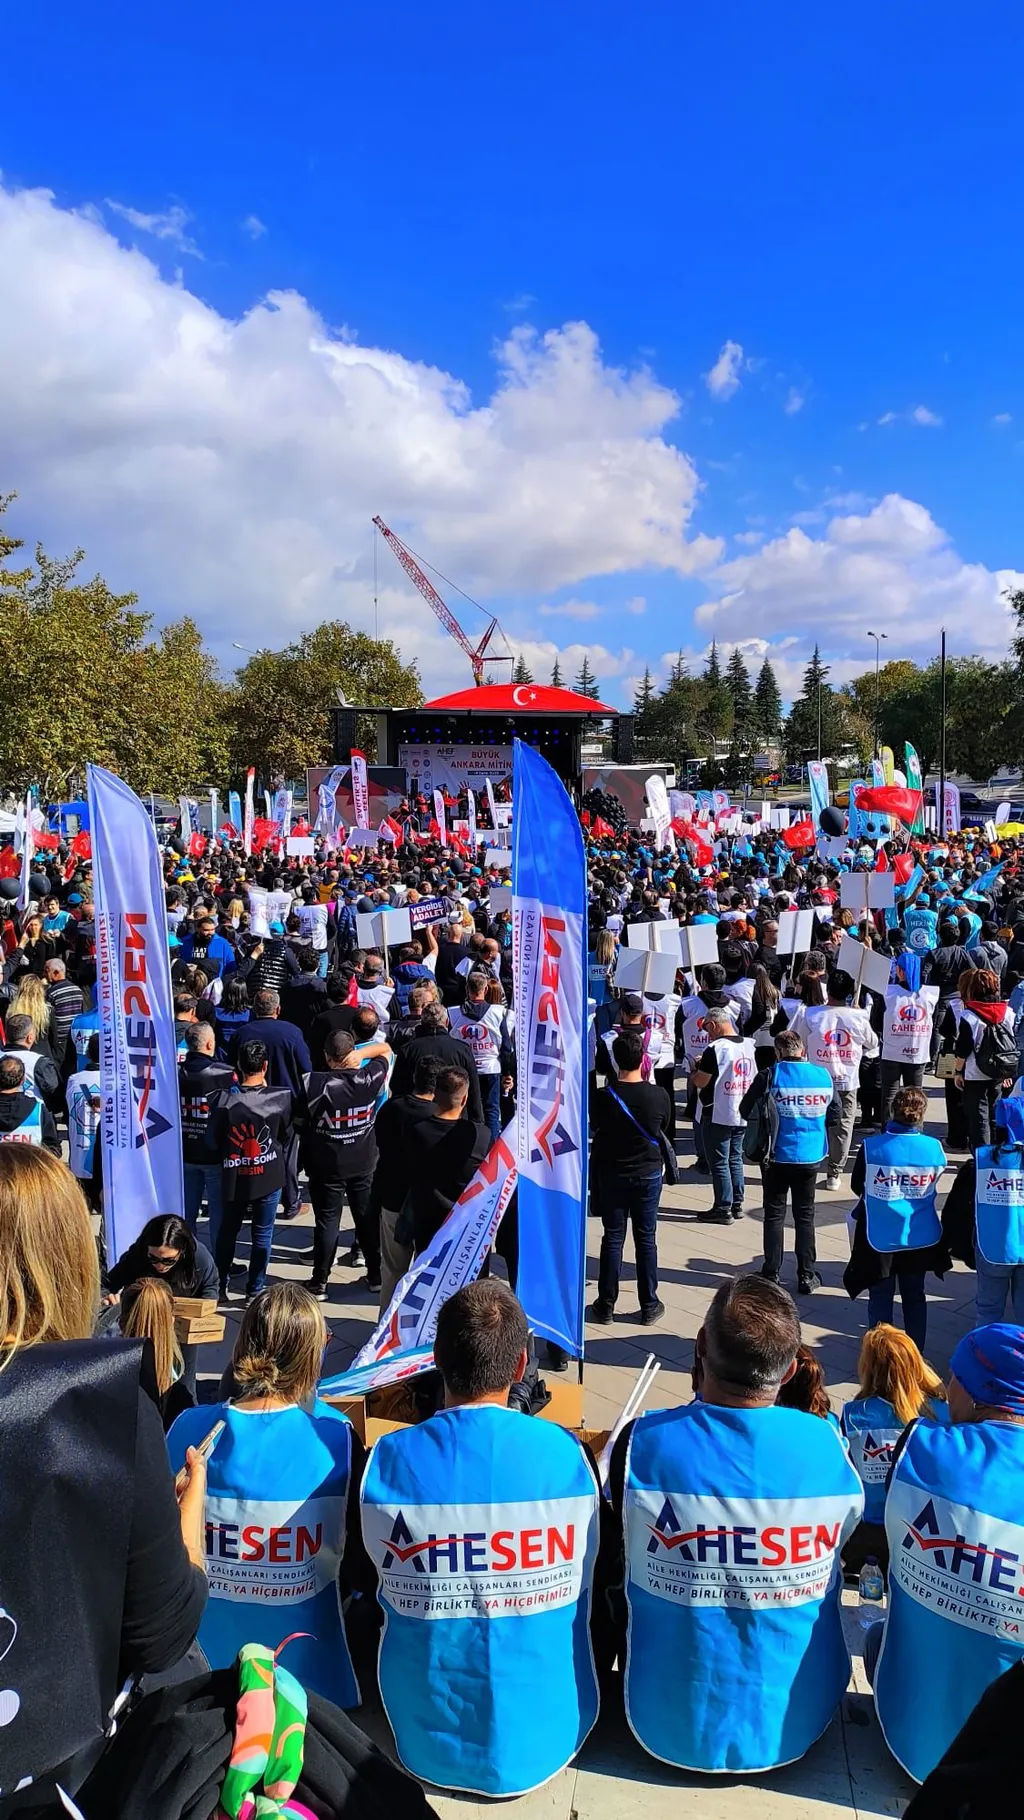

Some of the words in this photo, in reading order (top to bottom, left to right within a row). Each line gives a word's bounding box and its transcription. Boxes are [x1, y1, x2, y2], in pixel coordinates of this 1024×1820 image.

[450, 761, 485, 769] ANKARA
[471, 750, 500, 759] BÜYÜK
[410, 901, 443, 914] VERGİDE
[413, 908, 444, 921] ADALET
[253, 1150, 277, 1165] SONA
[874, 1166, 937, 1187] AHESEN
[380, 1509, 575, 1573] AHESEN
[645, 1496, 840, 1566] AHESEN
[901, 1498, 1024, 1597] AHE
[211, 1565, 269, 1579] ÇALIŞANLARI
[403, 1580, 452, 1592] HEKİMLİĞİ
[456, 1581, 522, 1592] ÇALIŞANLARI
[526, 1570, 572, 1587] SENDİKASI
[647, 1561, 665, 1574] AİLE
[668, 1569, 721, 1581] HEKİMLİĞİ
[725, 1574, 791, 1584] ÇALIŞANLARI
[901, 1556, 916, 1572] AİLE
[918, 1569, 971, 1599] HEKİMLİĞİ
[233, 1585, 247, 1595] YA
[647, 1577, 661, 1590] YA
[664, 1580, 685, 1596] HEP
[690, 1586, 751, 1602] BİRLİKTE,
[753, 1591, 768, 1600] YA
[900, 1571, 910, 1585] YA
[911, 1583, 932, 1600] HEP
[400, 1598, 419, 1609] HEP
[423, 1598, 482, 1611] BİRLİKTE,
[484, 1600, 499, 1609] YA
[504, 1586, 572, 1609] HİÇBİRİMİZ!
